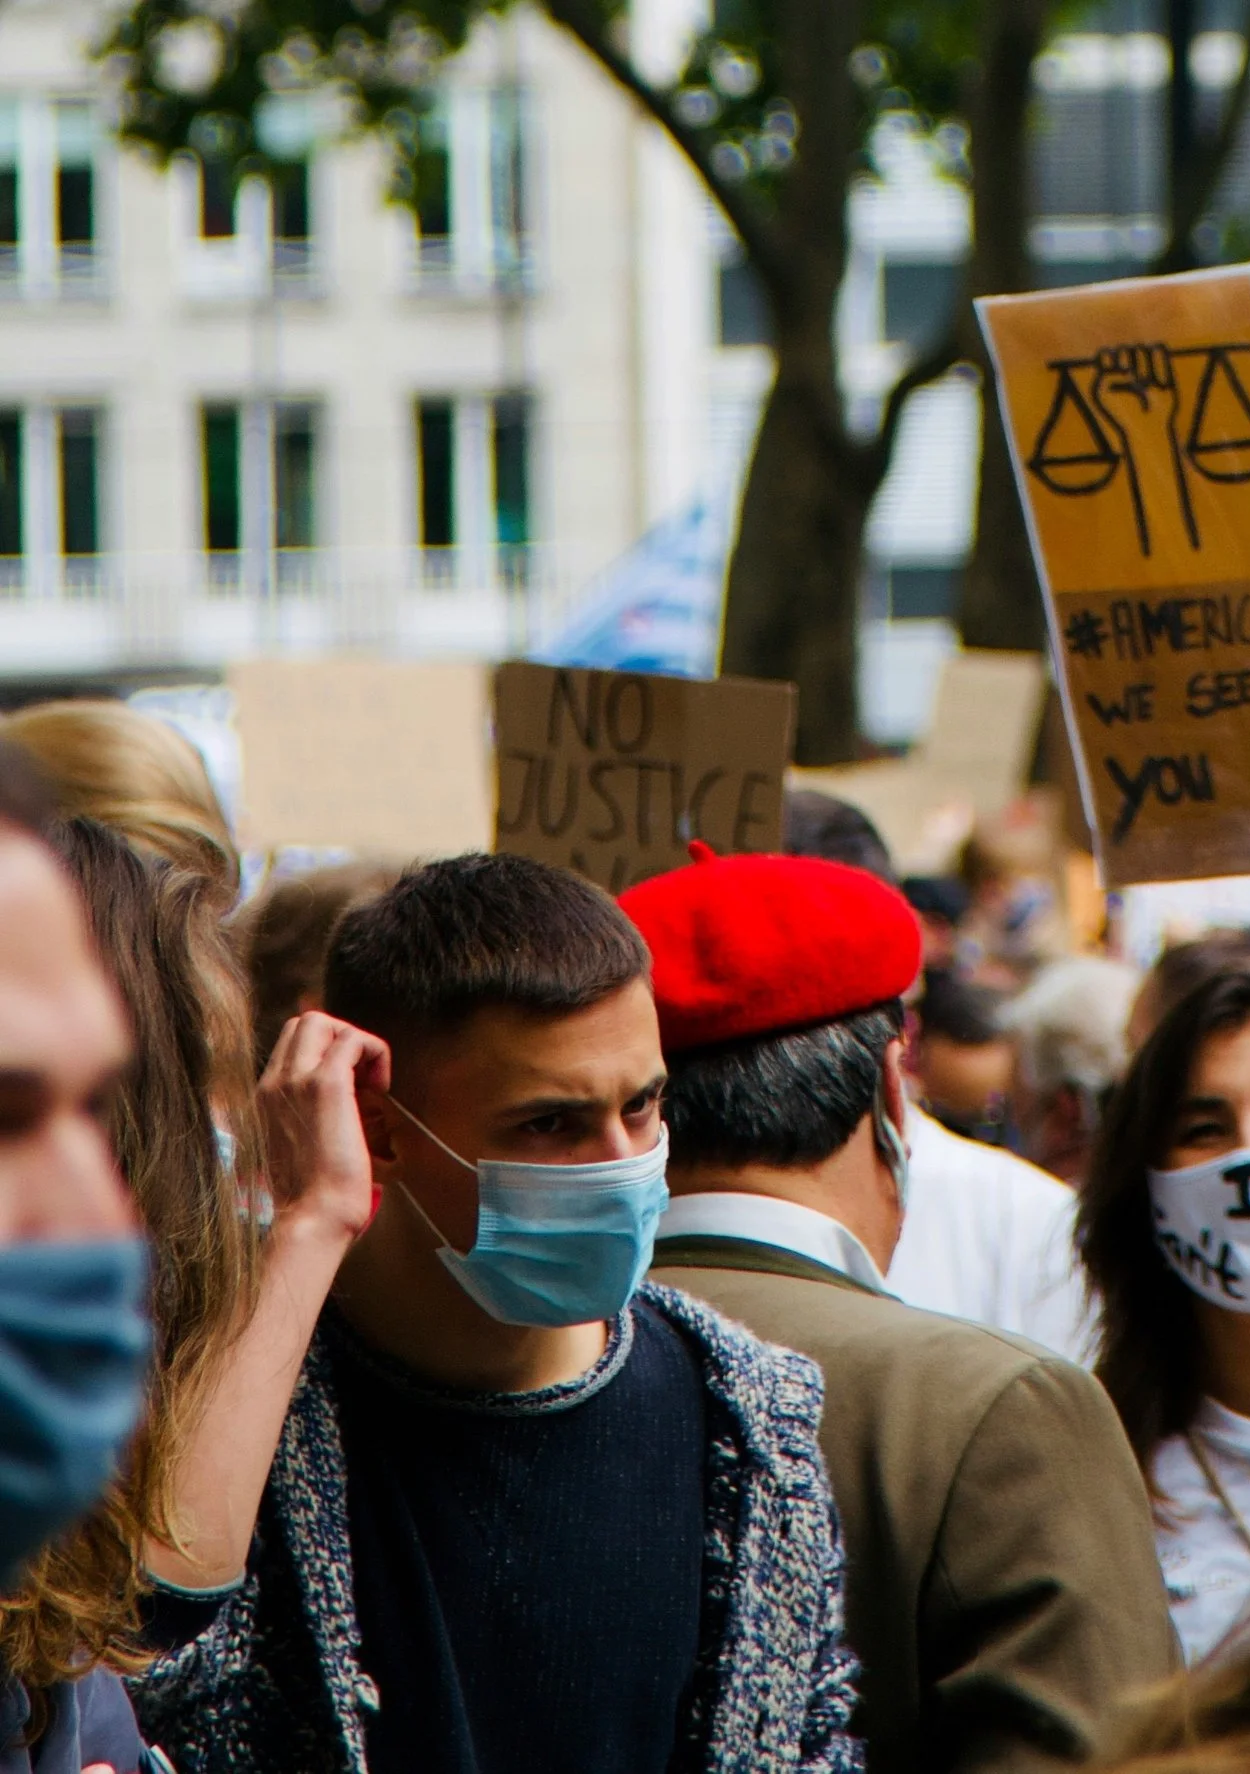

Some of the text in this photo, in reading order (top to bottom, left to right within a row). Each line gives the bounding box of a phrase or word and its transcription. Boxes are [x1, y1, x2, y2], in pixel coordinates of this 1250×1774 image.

[547, 667, 653, 753] NO
[1084, 682, 1156, 727] WE
[498, 750, 770, 854] JUSTICE
[1104, 752, 1216, 846] YOU
